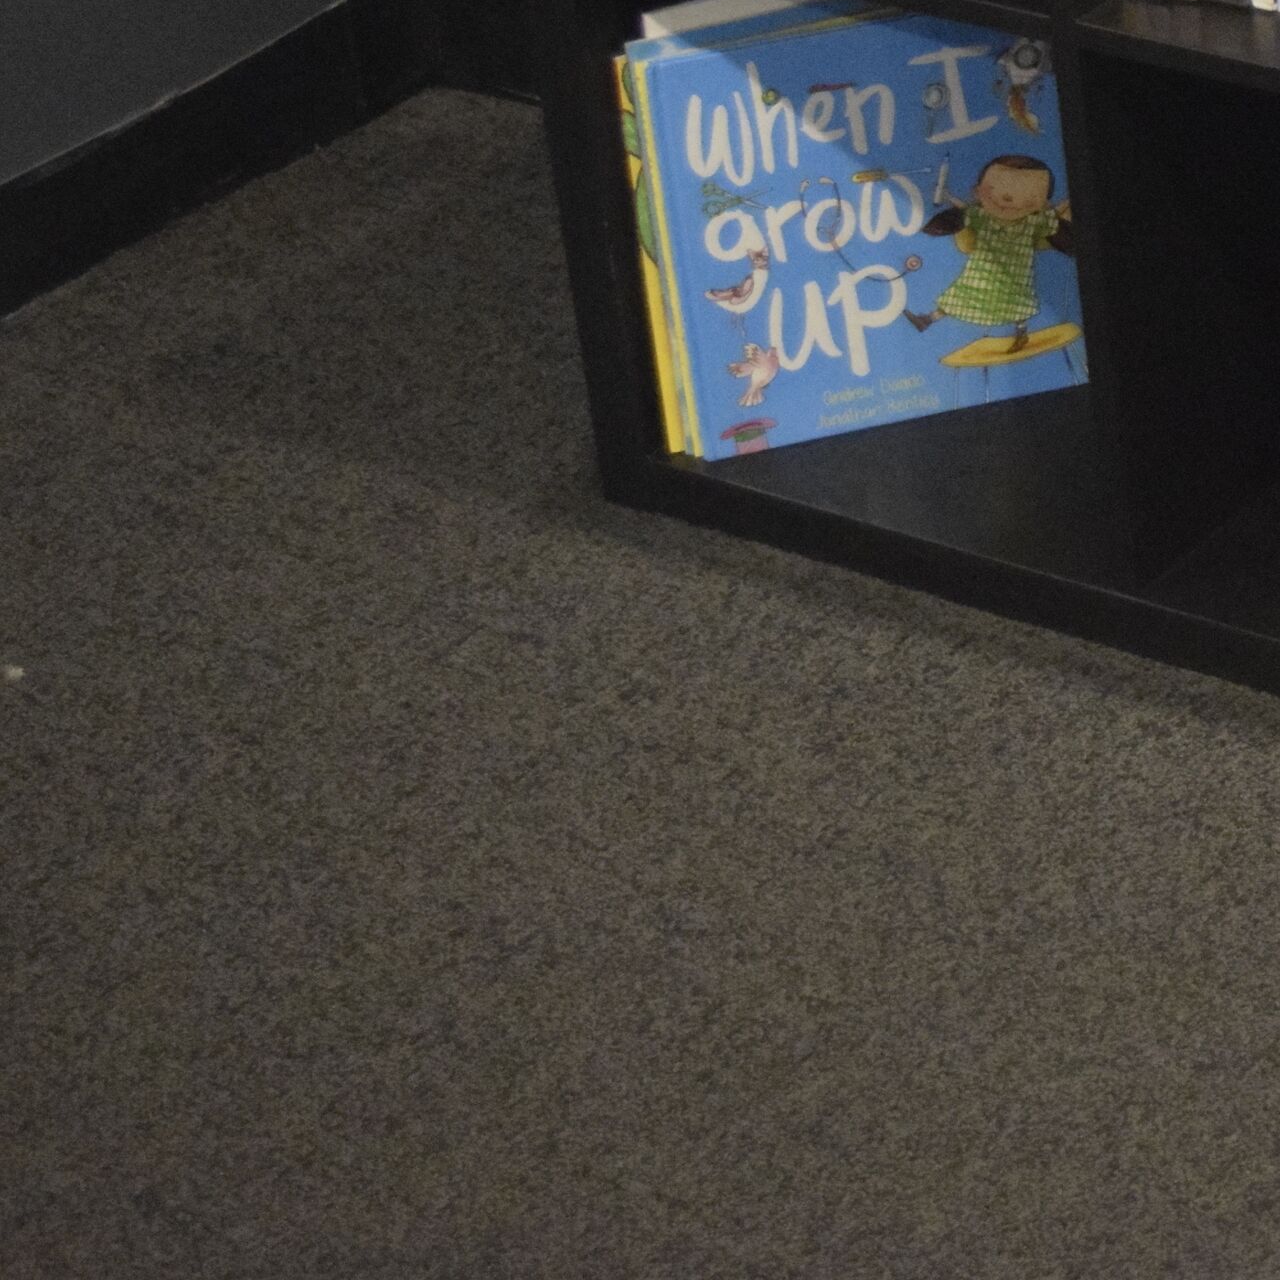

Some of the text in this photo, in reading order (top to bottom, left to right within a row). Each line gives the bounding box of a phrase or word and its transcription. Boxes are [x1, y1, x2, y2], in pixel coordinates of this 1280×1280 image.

[686, 45, 998, 186] When I
[704, 174, 926, 313] grow
[768, 264, 908, 377] up
